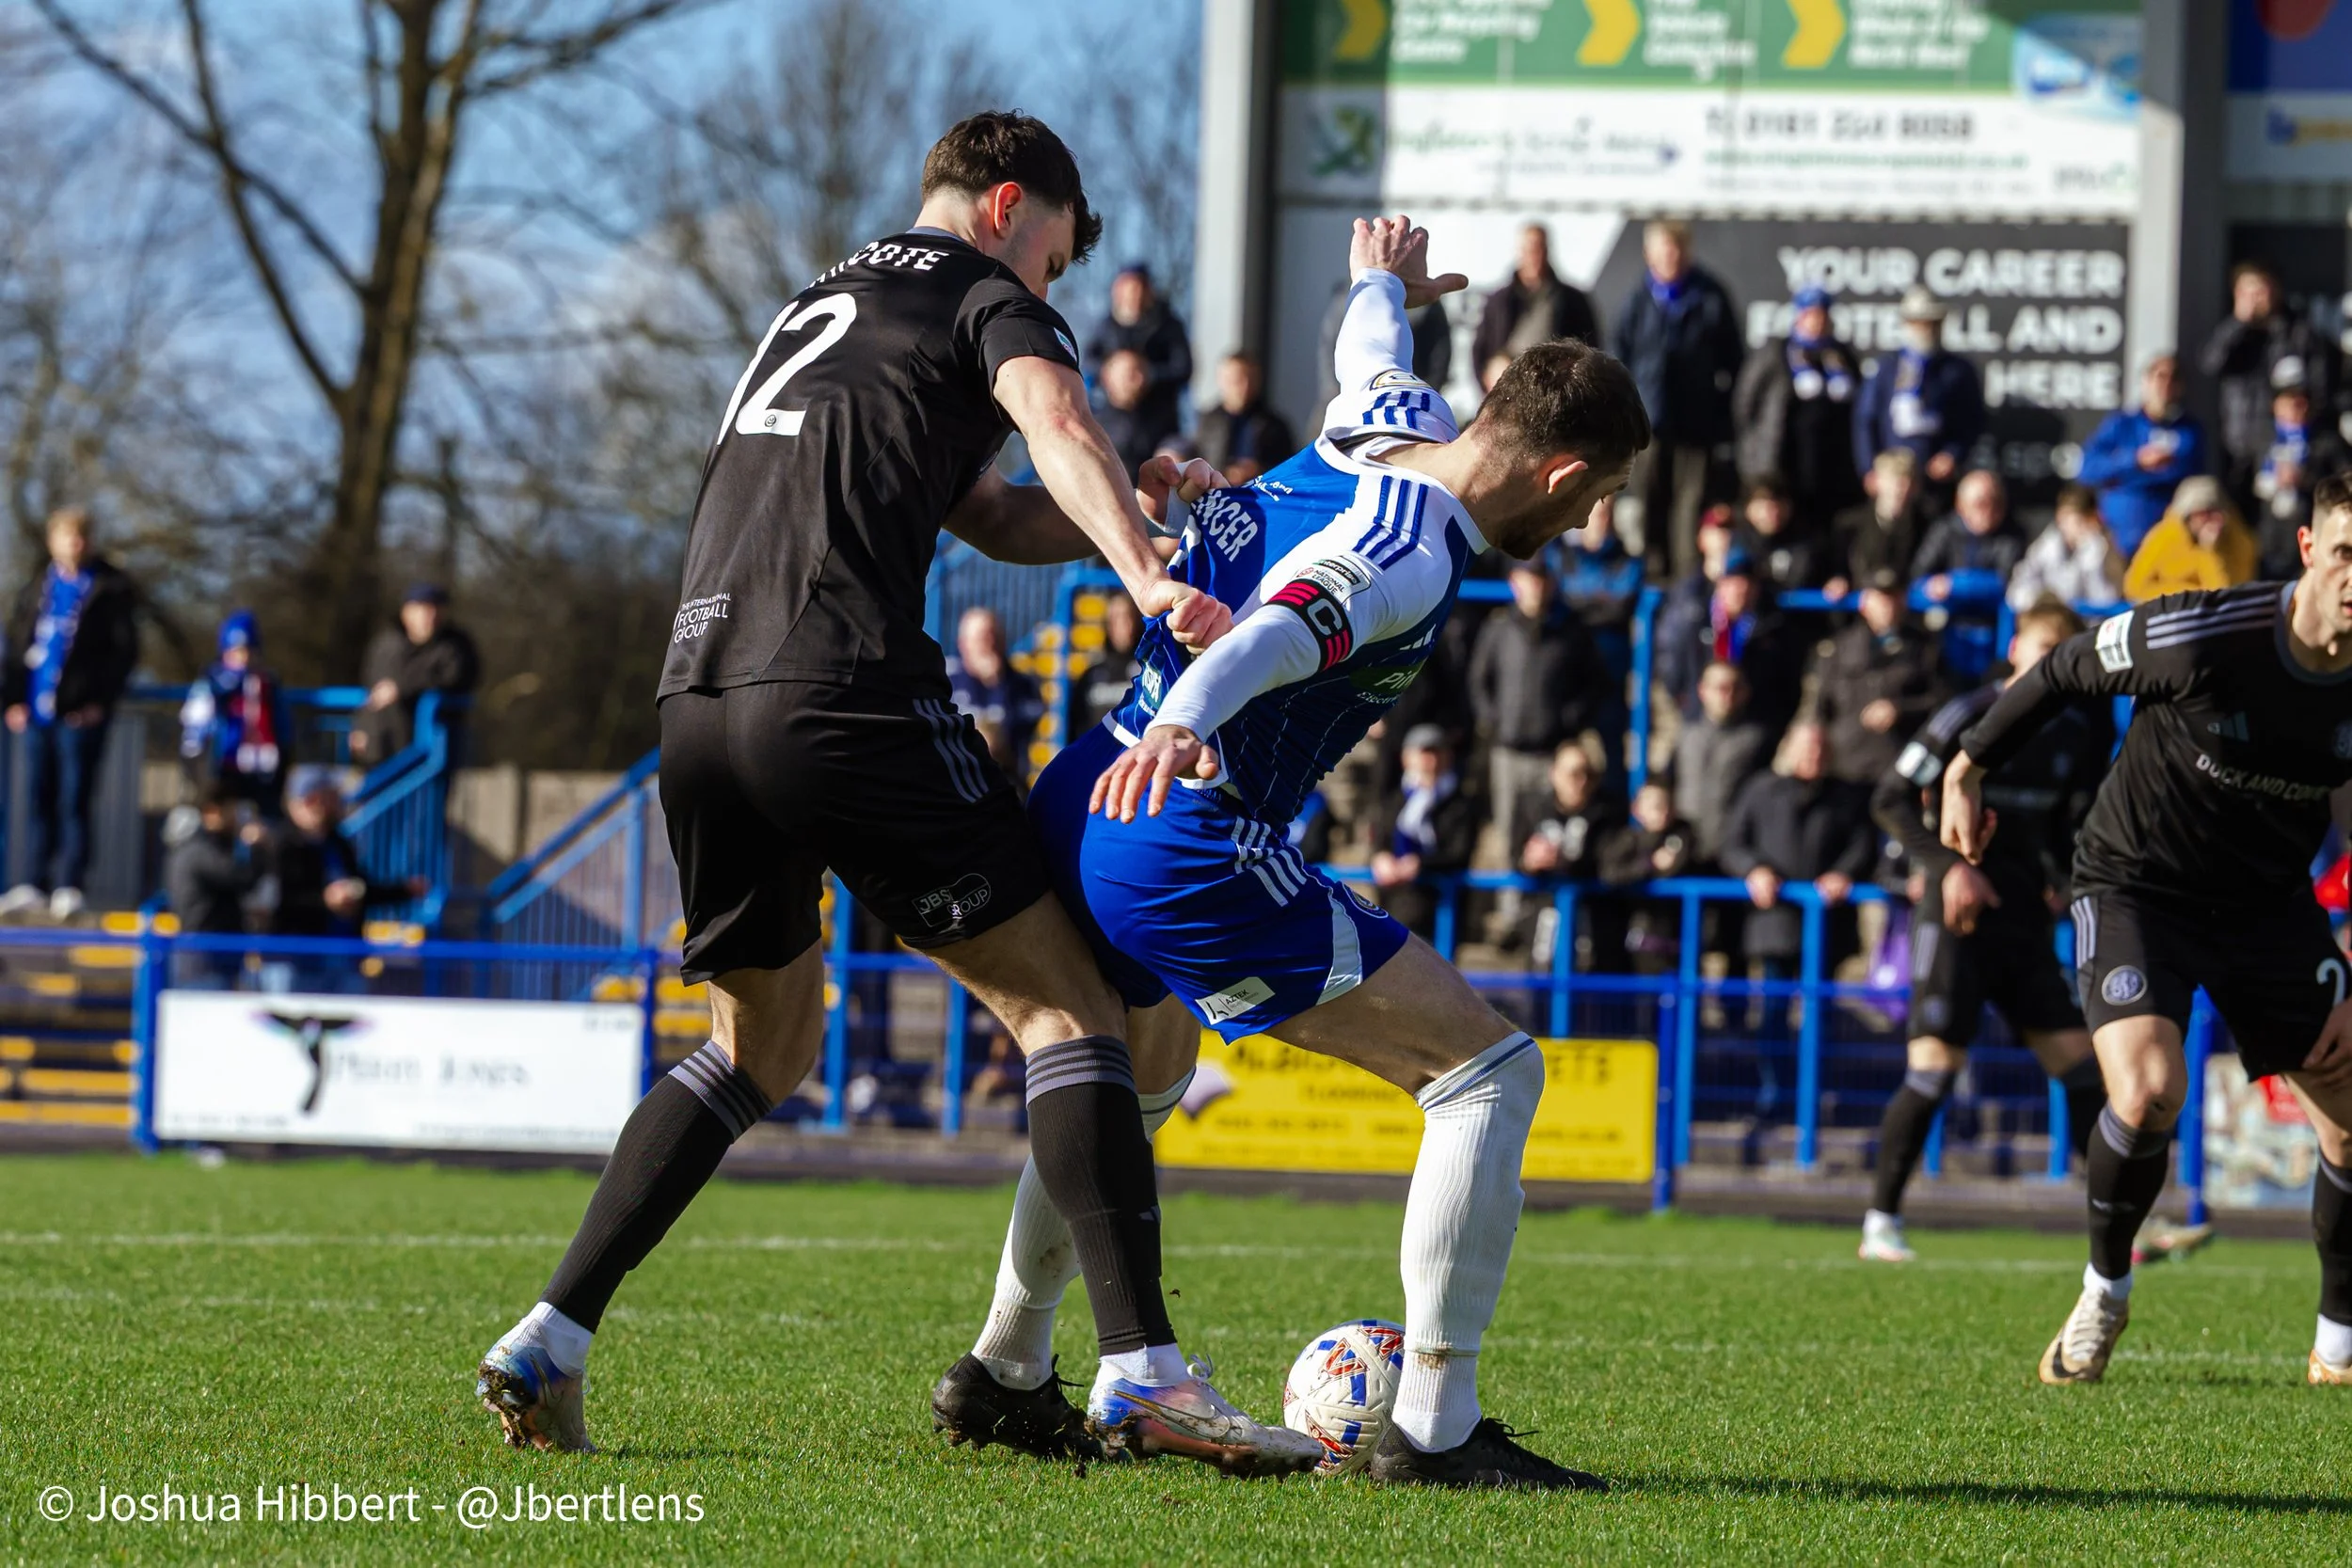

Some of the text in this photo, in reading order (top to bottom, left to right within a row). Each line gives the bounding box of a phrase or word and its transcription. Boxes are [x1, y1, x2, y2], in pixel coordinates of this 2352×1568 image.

[1780, 248, 2122, 295] YOUR CAREER
[2010, 308, 2121, 352] AND
[1987, 361, 2118, 407] HERE
[1312, 575, 1338, 595] LEAGUE
[1314, 569, 1345, 593] NATIONAL
[1307, 598, 1343, 636] C
[675, 622, 708, 643] GOUP
[2245, 773, 2286, 798] AND
[919, 889, 951, 911] JBS
[947, 889, 988, 916] GROUP
[1225, 989, 1249, 1005] AZTEK
